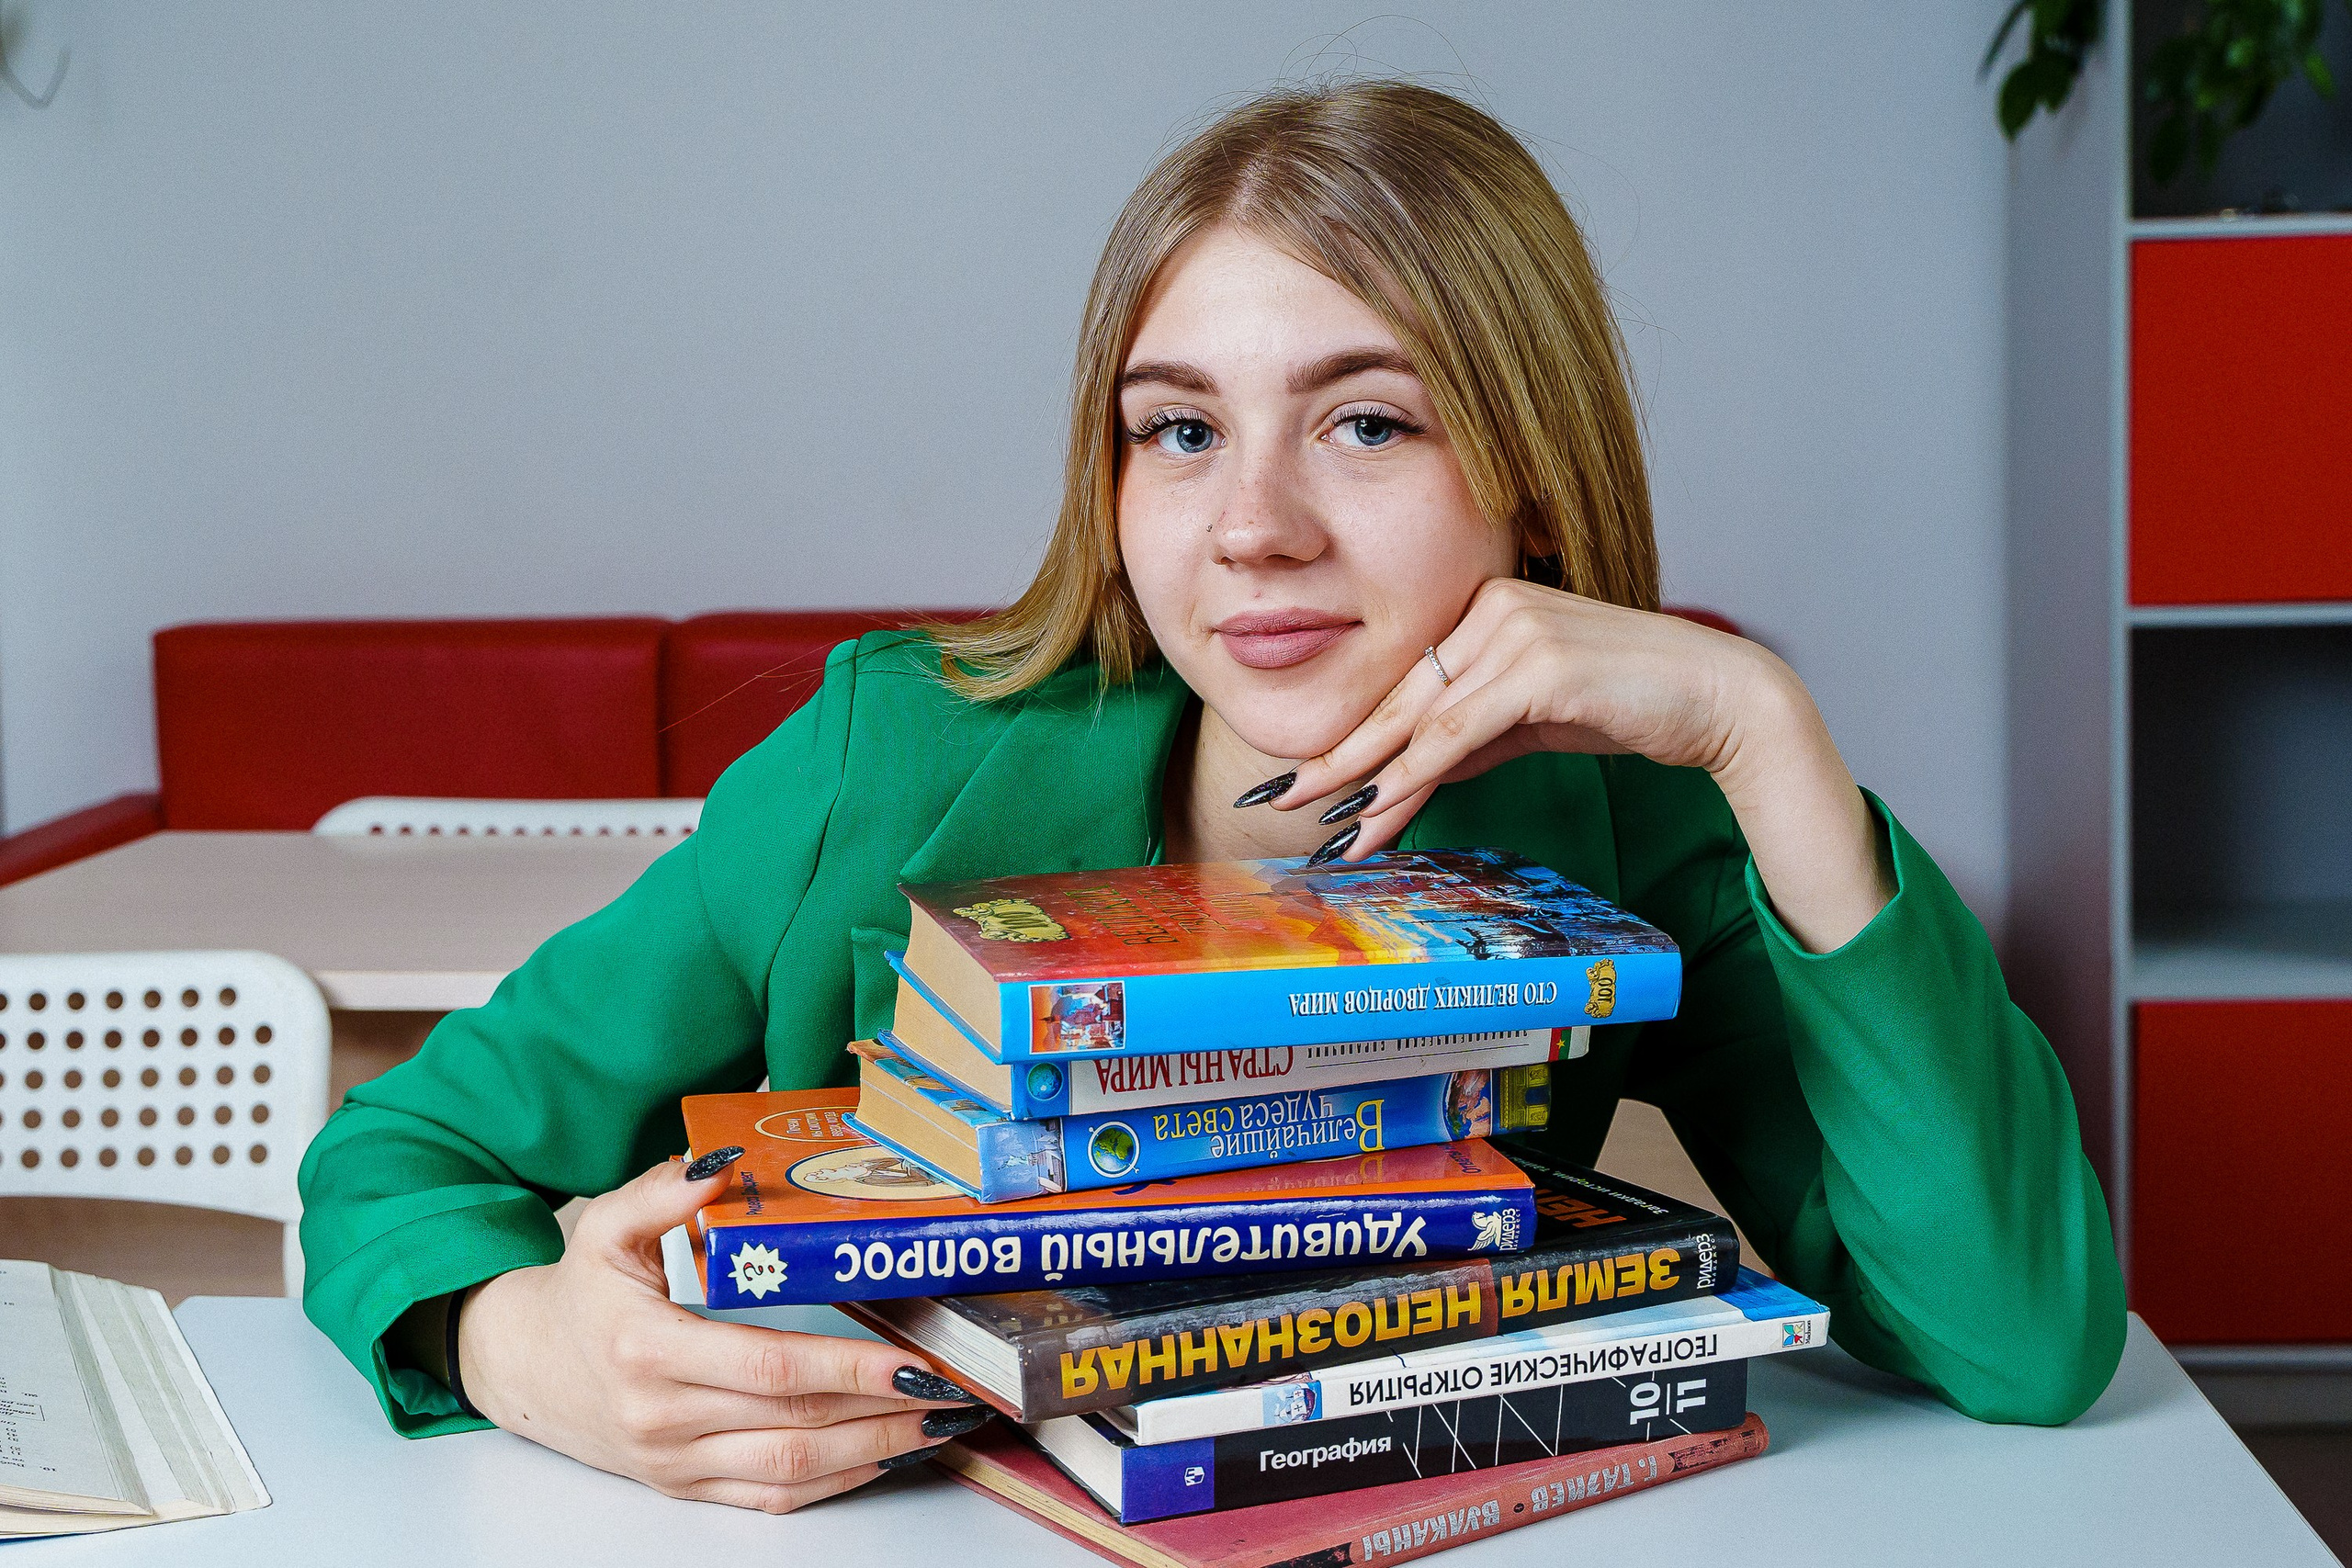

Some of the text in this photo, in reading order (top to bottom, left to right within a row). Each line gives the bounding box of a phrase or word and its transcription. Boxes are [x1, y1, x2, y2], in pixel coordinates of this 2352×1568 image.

[1288, 981, 1557, 1017] СТО ВЕЛИКИХ ДВОРЦОВ МИРА
[1097, 1045, 1295, 1095] СТРАНЫ МИРА
[1153, 1089, 1334, 1139] чудеса света
[1211, 1100, 1385, 1159] Величайшие
[1059, 1247, 1681, 1399] ЗЕМЛЯ НЕПОЗНАННАЯ
[1349, 1334, 1718, 1406] ГЕОГРАФИЧЕСКИЕ ОТКРЫТИЯ
[1630, 1382, 1660, 1425] 10
[1677, 1378, 1706, 1413] 11
[1261, 1436, 1392, 1472] География
[1531, 1462, 1634, 1513] ТАЗИЕВ
[1362, 1499, 1500, 1562] ВУЛКАНЫ
